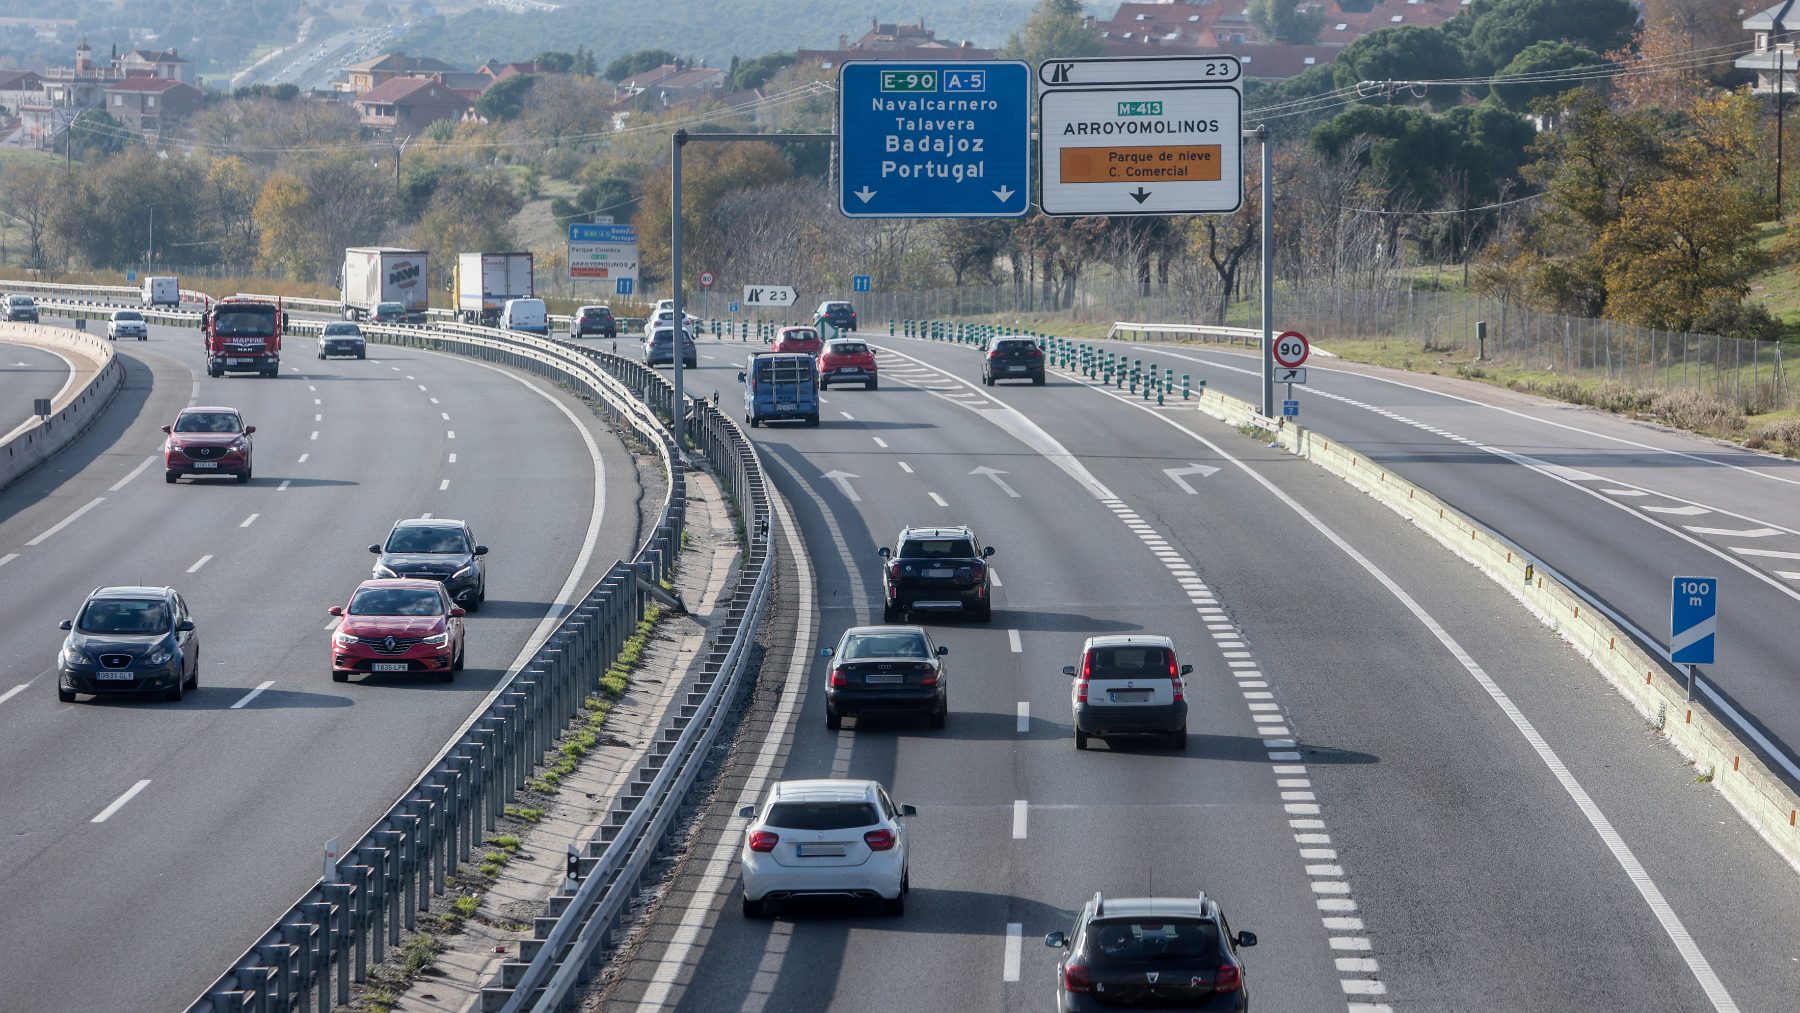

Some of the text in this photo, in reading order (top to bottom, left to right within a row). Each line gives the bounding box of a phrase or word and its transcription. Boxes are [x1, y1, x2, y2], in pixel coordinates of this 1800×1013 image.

[1205, 63, 1229, 76] 23
[884, 74, 982, 88] E-90 A-5
[872, 97, 998, 111] Navalcarnero
[1119, 102, 1161, 115] M-413
[895, 117, 975, 131] Talavera
[1063, 120, 1219, 136] ARROYOMOLINOS
[885, 135, 984, 158] Badajoz
[1108, 150, 1212, 164] Parque de nieve
[881, 160, 984, 184] Portugal
[1108, 166, 1188, 177] C. Comercial
[770, 291, 787, 300] 23
[1281, 343, 1301, 355] 90
[1681, 582, 1709, 595] 100
[1689, 597, 1702, 606] m
